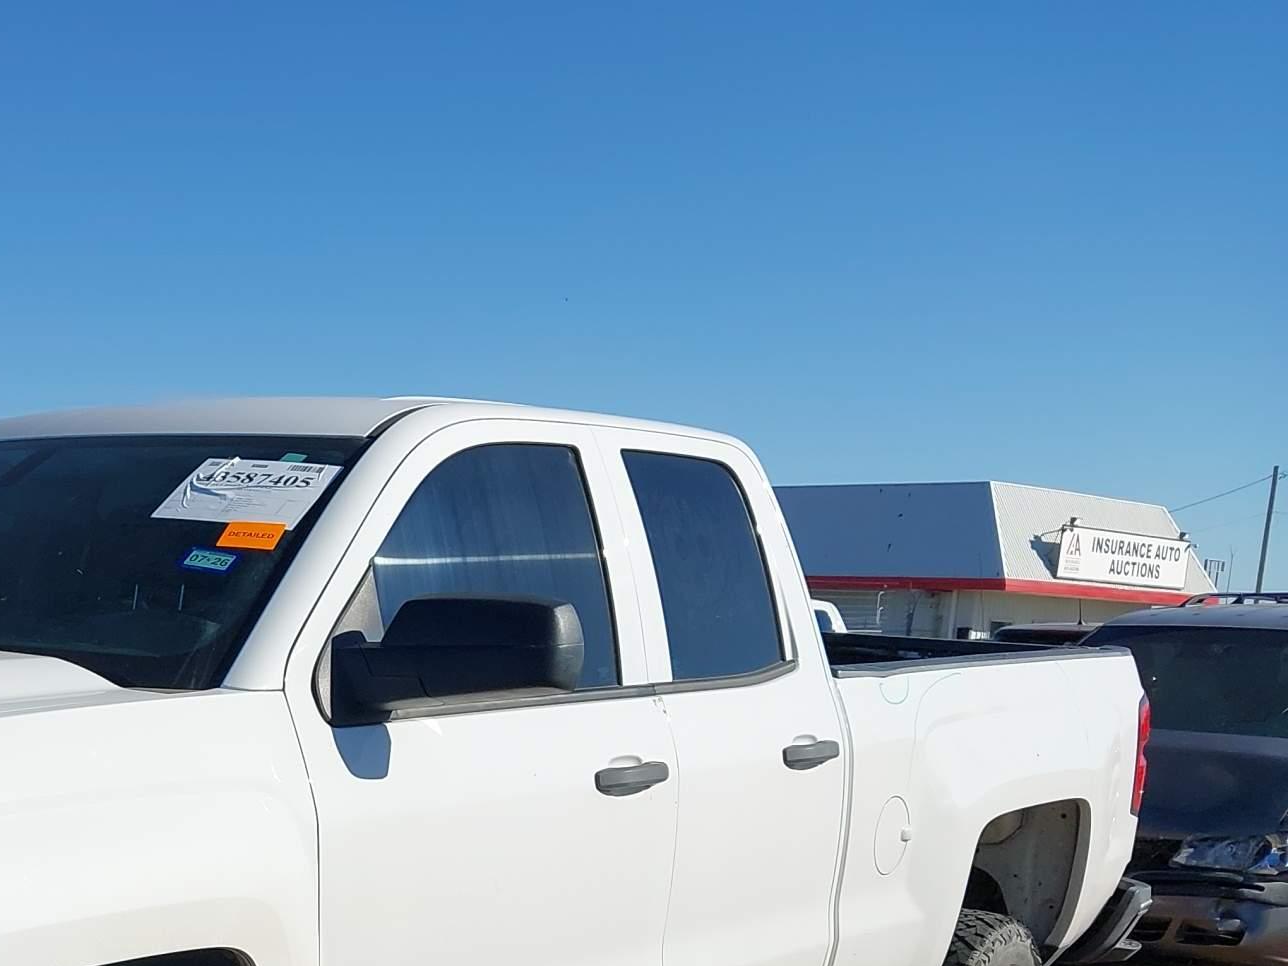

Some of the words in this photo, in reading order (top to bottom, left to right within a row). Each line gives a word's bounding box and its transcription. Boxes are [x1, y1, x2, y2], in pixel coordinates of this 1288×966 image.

[228, 530, 275, 540] DETAILED
[1091, 536, 1152, 560] INSURANCE
[1153, 545, 1182, 563] AUTO
[1108, 558, 1161, 580] AUCTIONS
